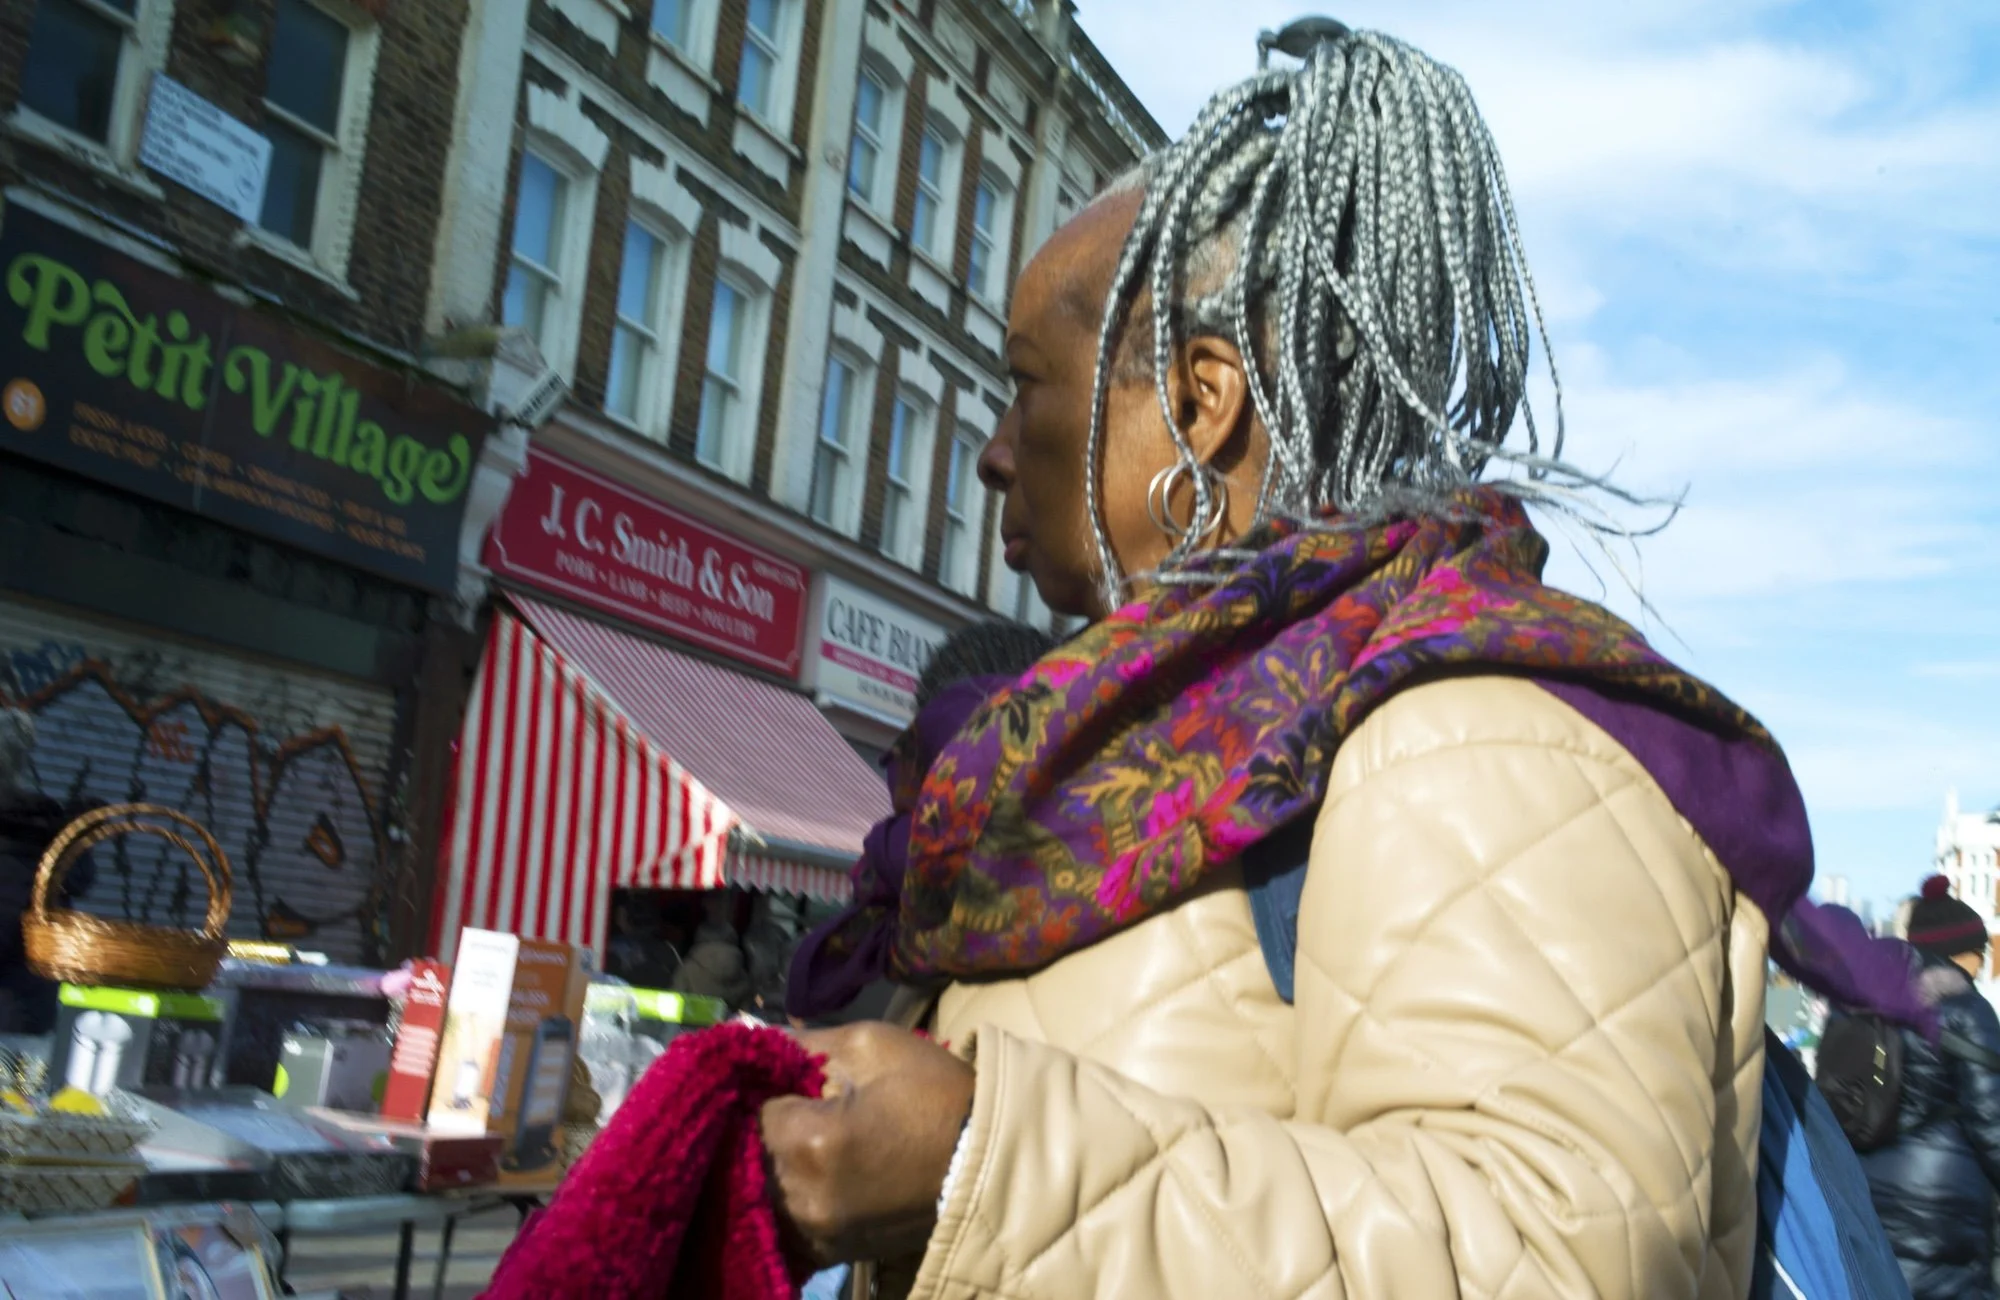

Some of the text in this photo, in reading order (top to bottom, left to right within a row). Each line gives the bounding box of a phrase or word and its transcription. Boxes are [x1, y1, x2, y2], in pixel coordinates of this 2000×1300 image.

[8, 253, 212, 410] Petit
[224, 346, 470, 504] Village
[541, 482, 566, 539] J.
[574, 497, 605, 555] C.
[611, 512, 694, 591] Smith
[698, 546, 724, 604] &
[727, 562, 774, 623] Son
[555, 549, 597, 583] PORK
[827, 597, 884, 656] CAFE
